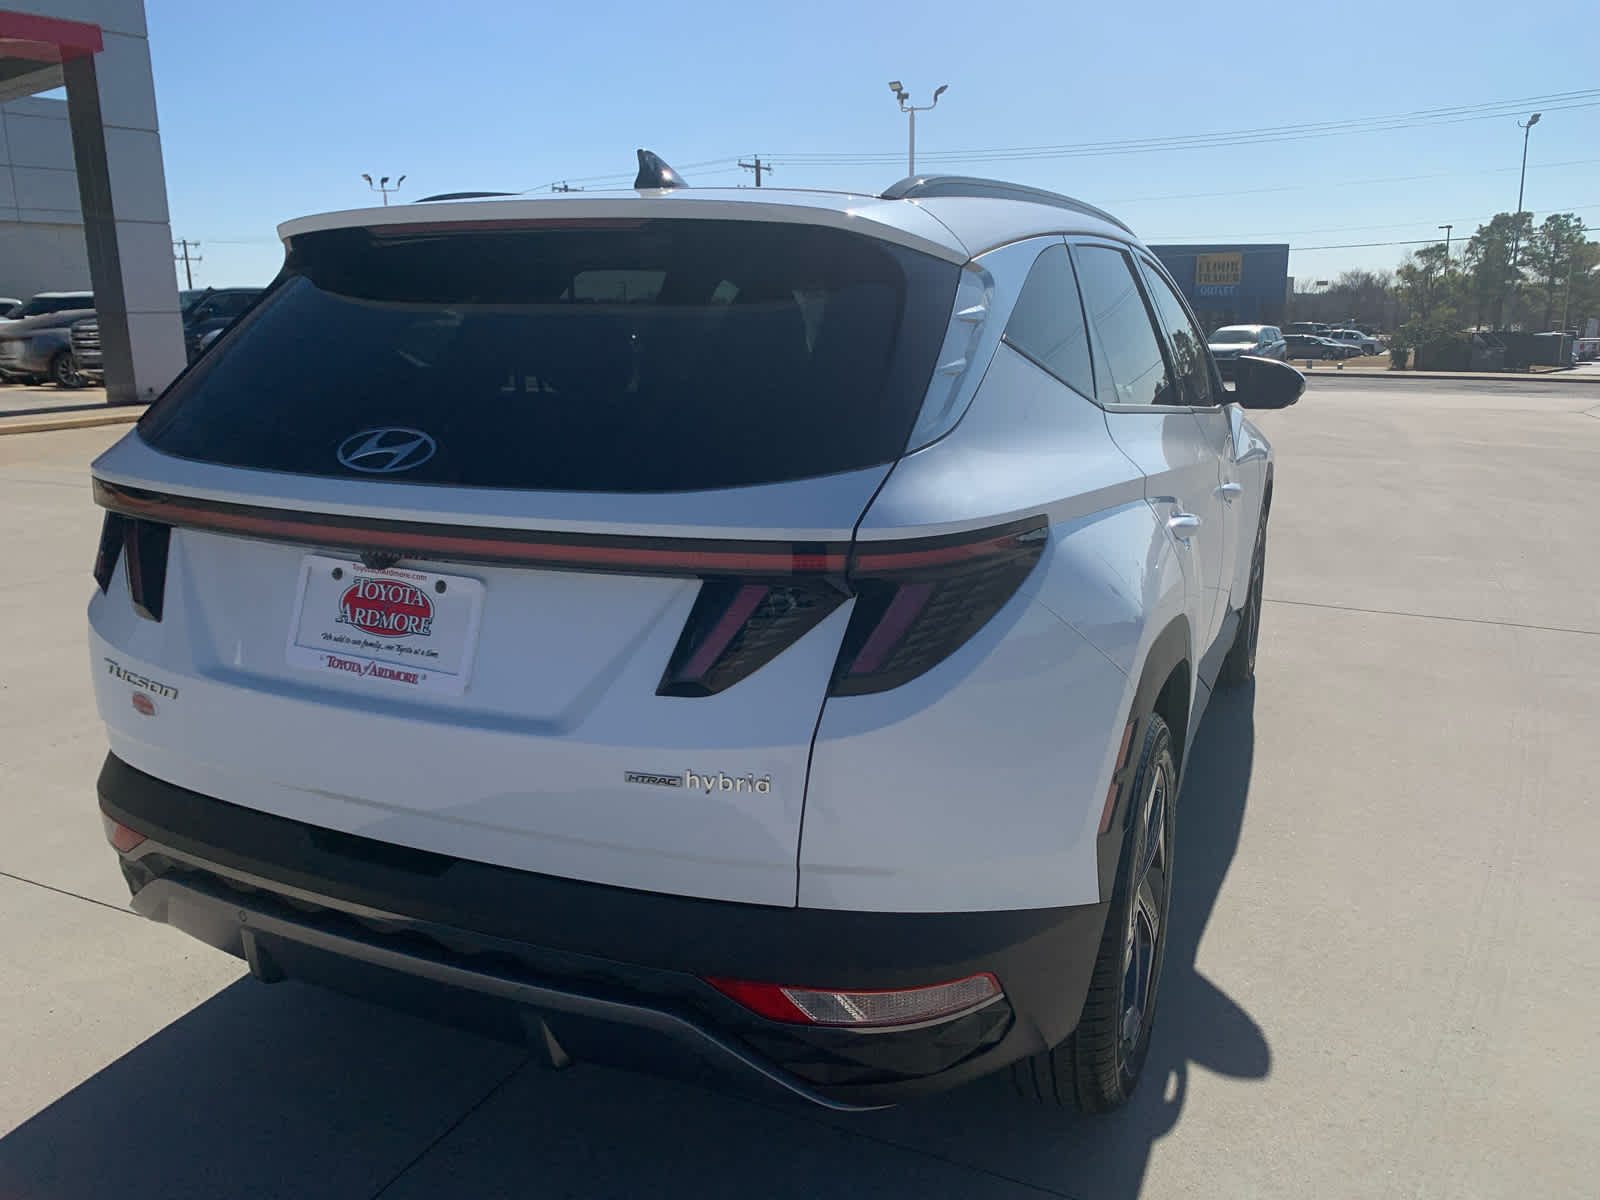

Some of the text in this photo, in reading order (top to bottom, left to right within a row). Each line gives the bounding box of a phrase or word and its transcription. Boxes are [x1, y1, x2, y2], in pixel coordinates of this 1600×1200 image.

[353, 576, 424, 607] TOYOTA
[335, 602, 432, 636] ARDMORE
[103, 656, 179, 700] TUCSON
[326, 655, 362, 673] TOYOTA
[368, 663, 419, 685] ARDMORE
[627, 769, 771, 794] HTRAC hybrid
